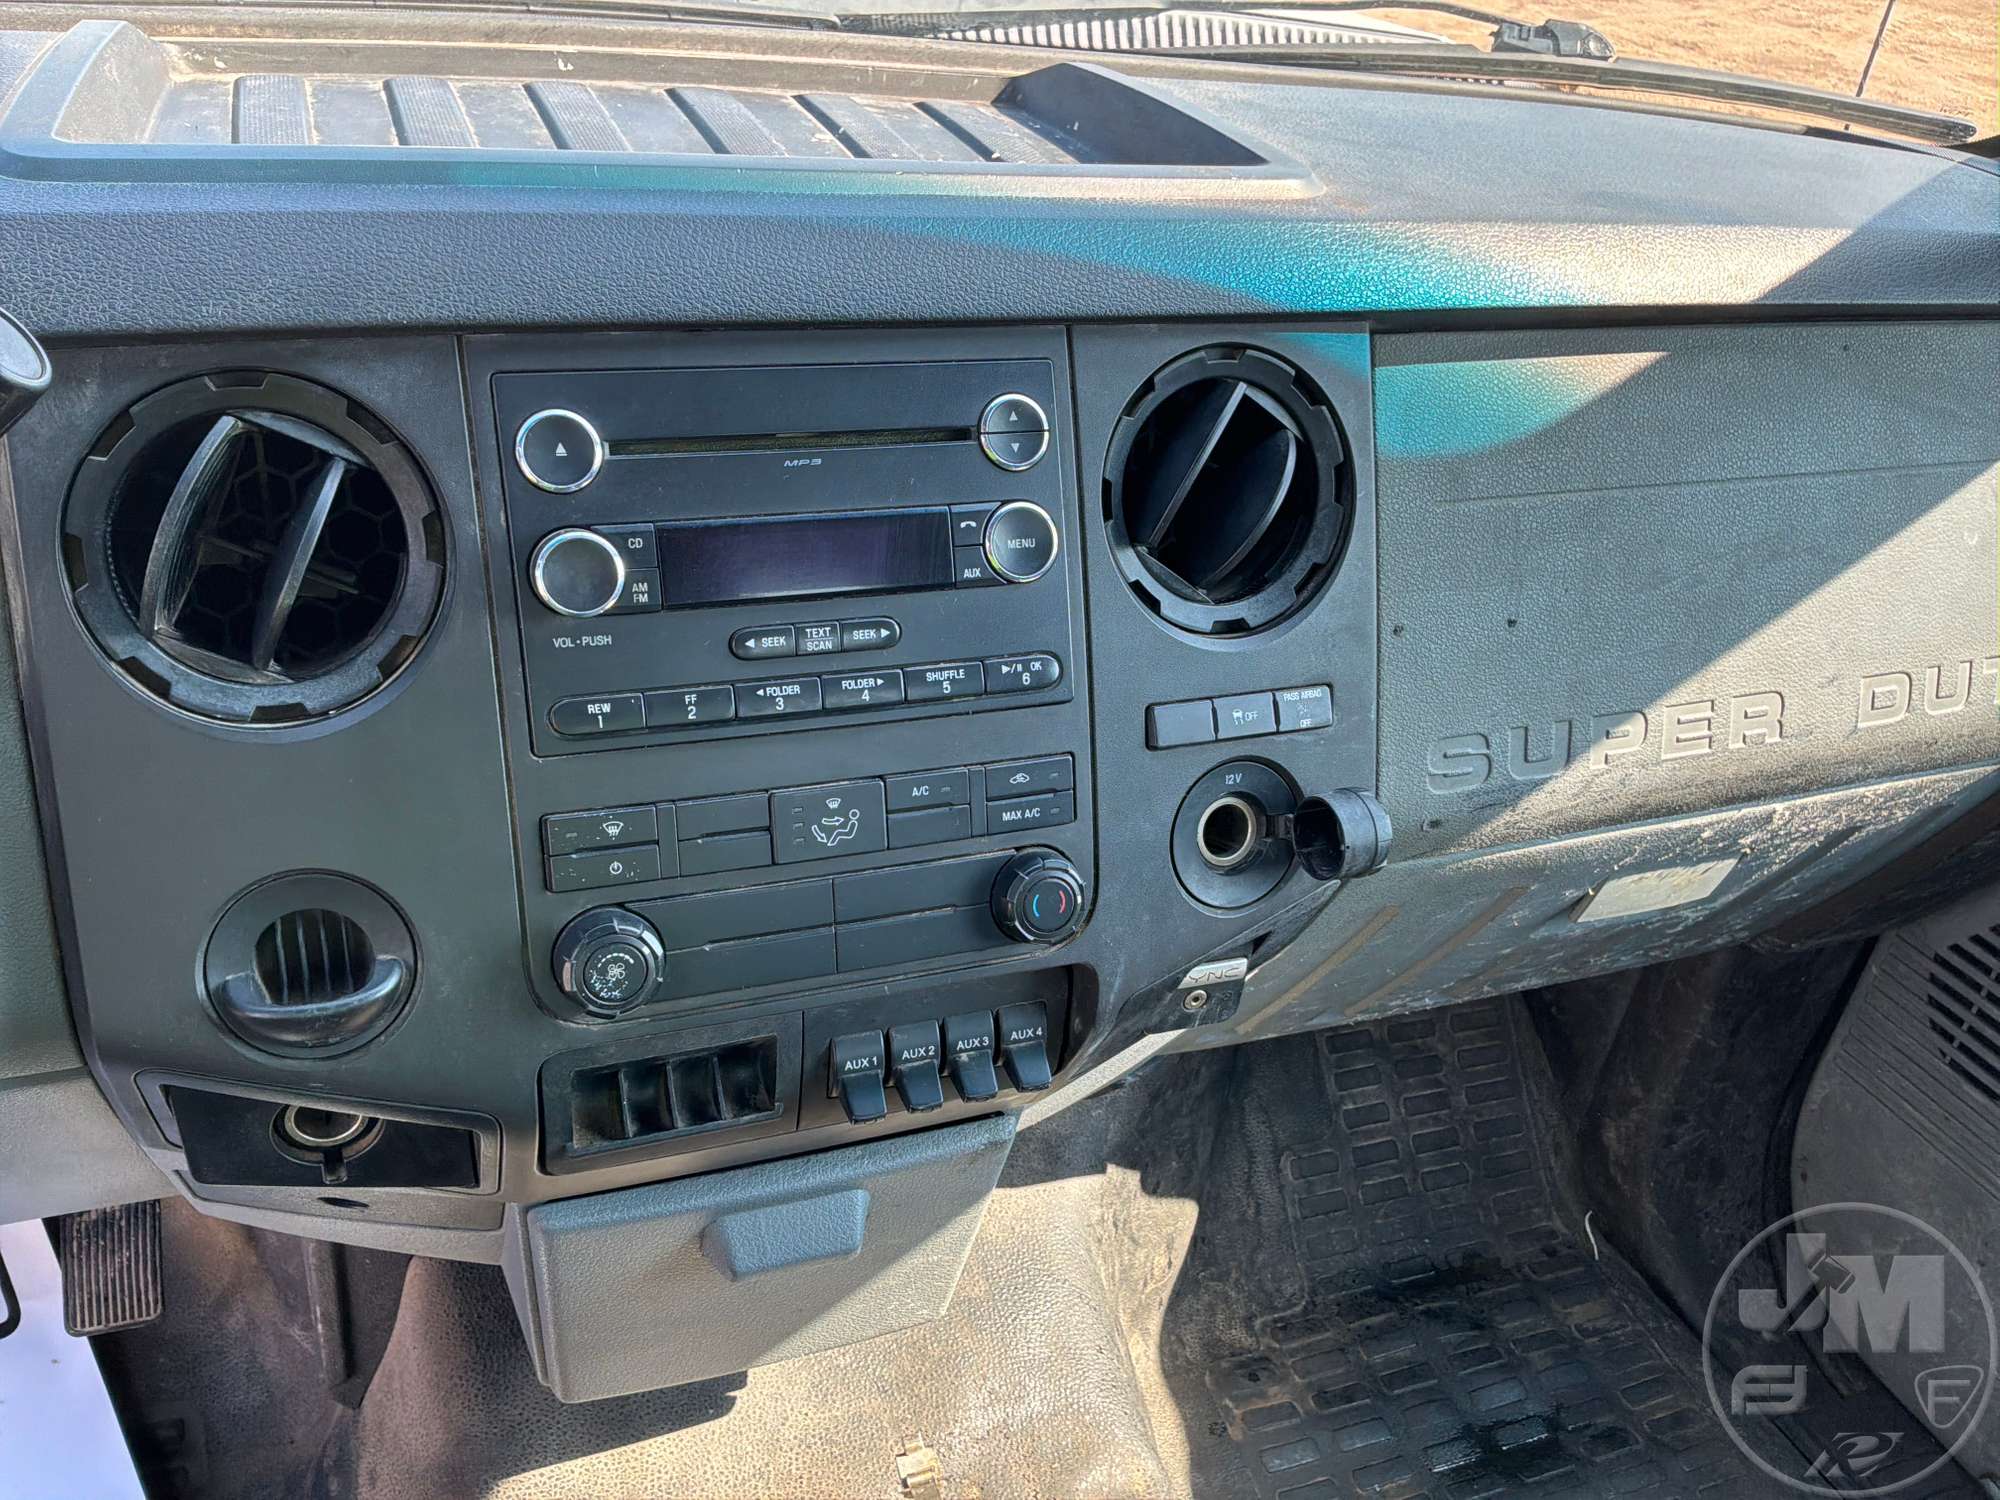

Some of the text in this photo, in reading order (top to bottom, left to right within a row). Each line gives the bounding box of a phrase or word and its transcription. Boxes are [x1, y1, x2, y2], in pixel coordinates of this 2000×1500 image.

[783, 458, 822, 467] MP3
[627, 537, 643, 549] CD
[1007, 538, 1036, 549] MENU
[963, 567, 981, 578] AUX
[631, 582, 649, 593] AM
[633, 593, 649, 604] FM
[805, 626, 832, 639] TEXT
[852, 628, 877, 640] SEEK
[761, 636, 787, 648] SEEK
[806, 639, 833, 652] SCAN
[1030, 661, 1043, 672] OK
[926, 668, 966, 682] SHUFFLE
[1022, 672, 1031, 685] 6
[841, 677, 876, 690] FOLDER
[942, 680, 952, 694] 5
[766, 684, 801, 697] FOLDER
[861, 689, 871, 702] 4
[1283, 691, 1300, 702] PASS
[684, 695, 698, 706] FF
[775, 697, 785, 711] 3
[587, 703, 612, 715] REW
[687, 706, 697, 720] 2
[597, 715, 605, 729] 1
[1245, 711, 1259, 721] OFF
[1299, 718, 1313, 728] OFF
[1427, 691, 1785, 794] SUPER
[911, 785, 929, 797] A/C
[1002, 808, 1041, 822] MAX A/C
[1010, 1026, 1044, 1041] AUX 4
[956, 1036, 990, 1050] AUX 3
[901, 1045, 936, 1061] AUX 2
[844, 1057, 878, 1071] AUX 1
